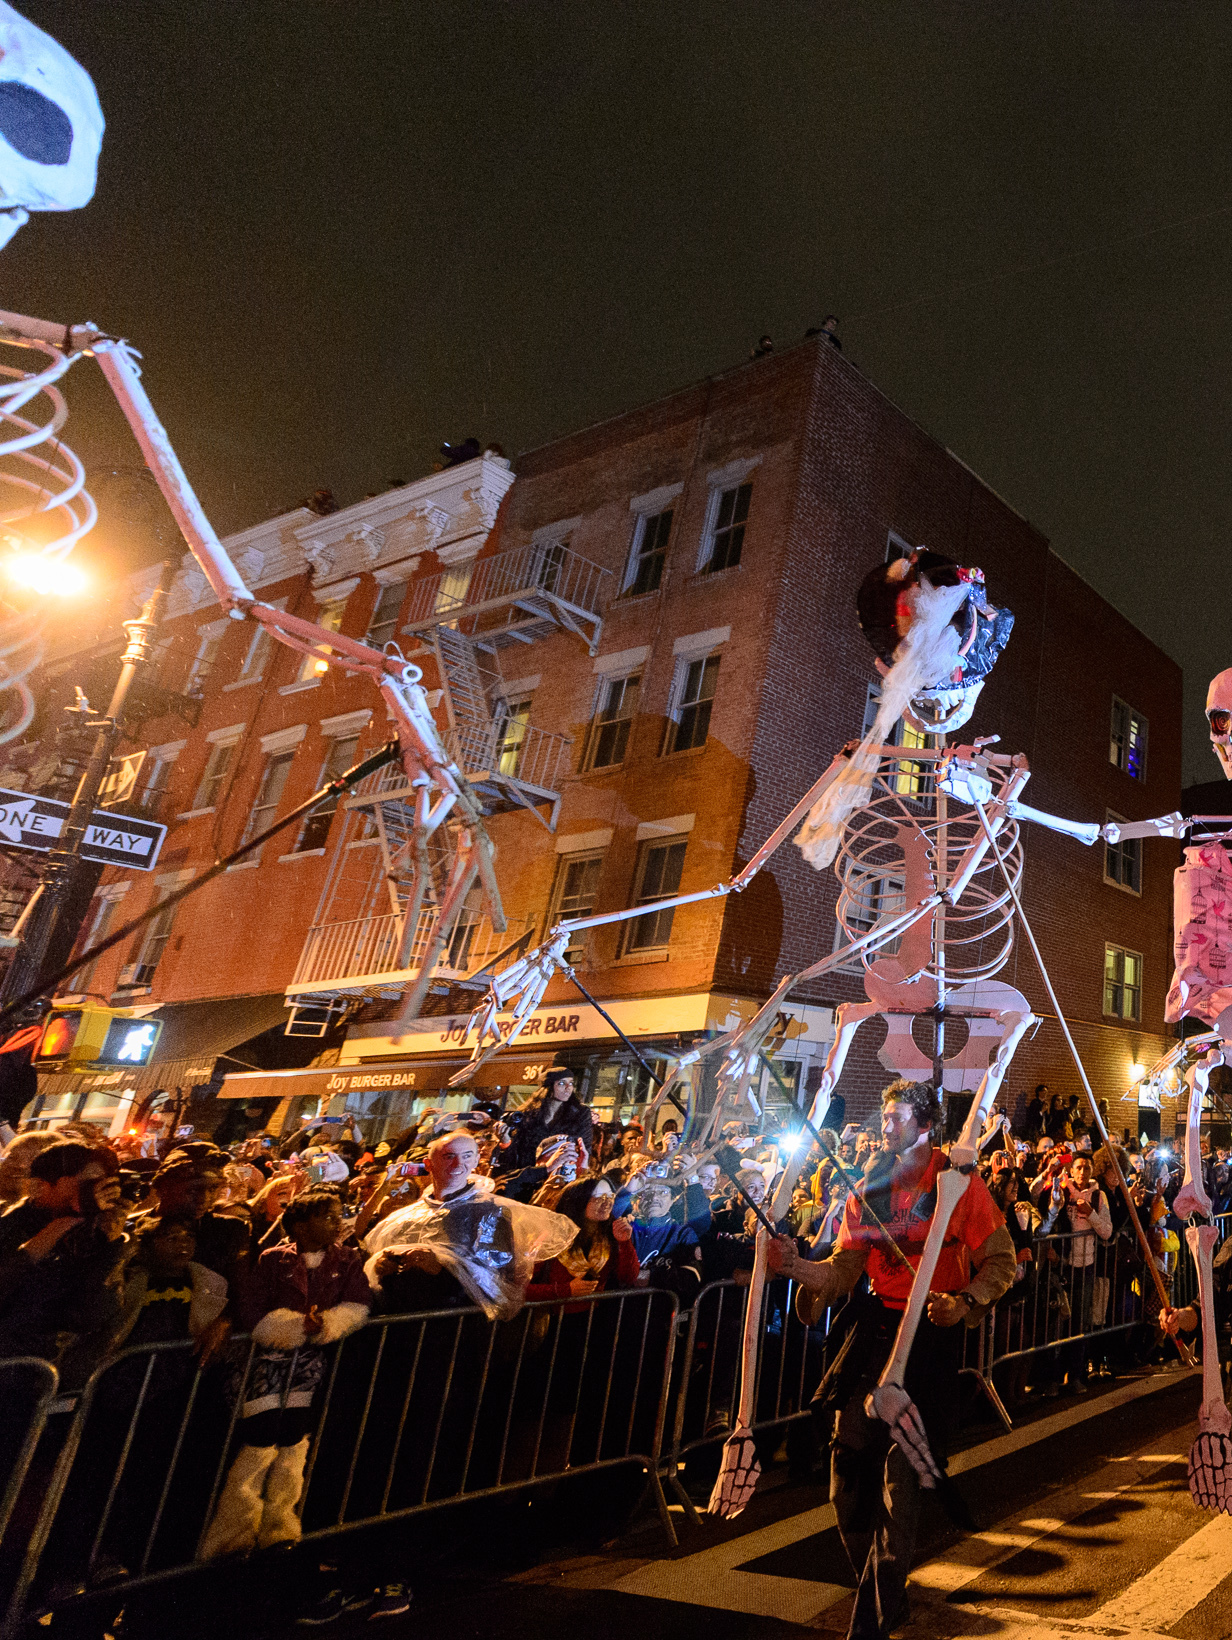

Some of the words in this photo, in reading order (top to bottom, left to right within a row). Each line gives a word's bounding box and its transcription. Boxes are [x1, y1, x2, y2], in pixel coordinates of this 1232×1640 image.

[0, 808, 47, 832] ONE
[91, 828, 142, 850] WAY
[480, 1018, 541, 1039] URER
[544, 1014, 580, 1034] BAR
[326, 1073, 350, 1093] Joy
[349, 1074, 392, 1088] BURGER
[391, 1072, 416, 1086] BAR
[522, 1064, 544, 1080] 361
